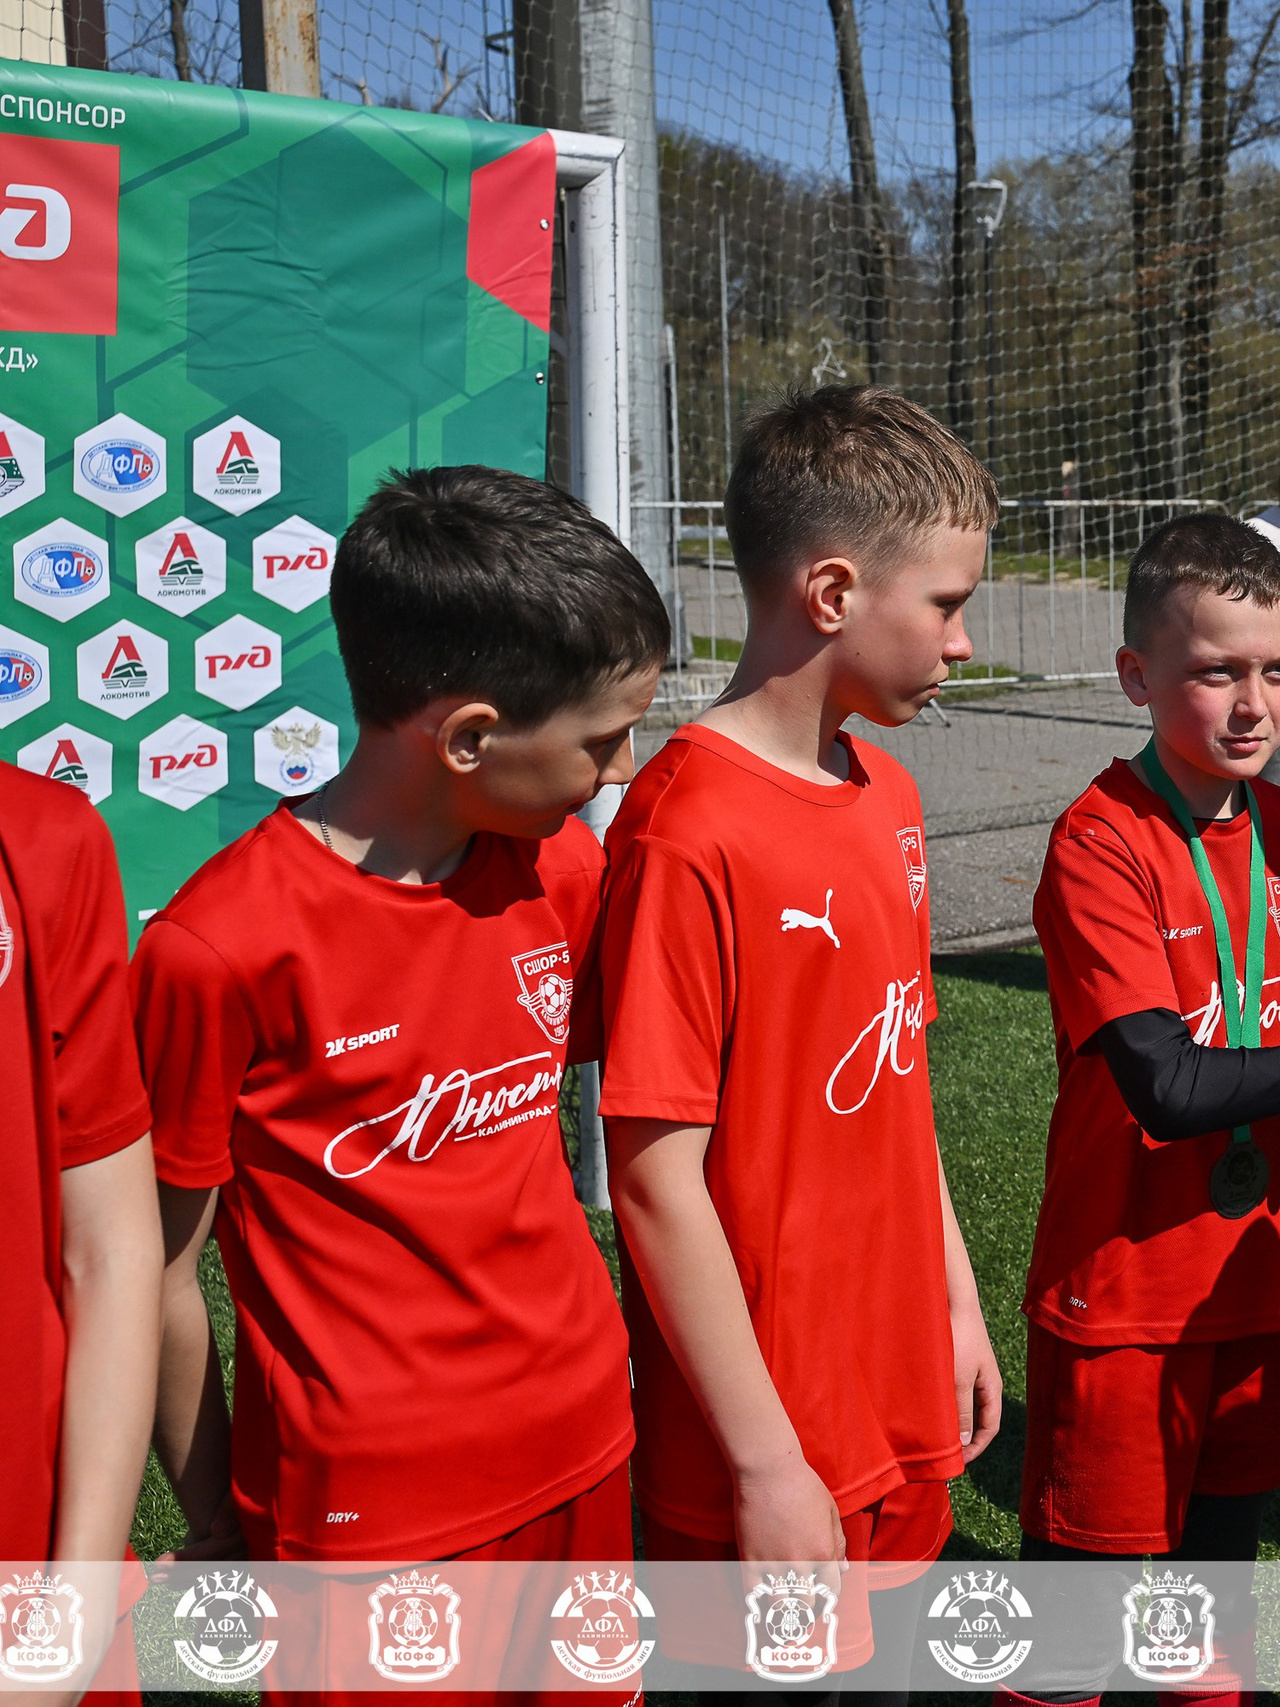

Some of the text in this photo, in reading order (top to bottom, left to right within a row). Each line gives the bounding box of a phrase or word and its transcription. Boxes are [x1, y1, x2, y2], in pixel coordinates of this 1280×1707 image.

[0, 94, 126, 129] СПОНСОР
[96, 453, 145, 478] ДФЛ
[213, 488, 262, 496] ЛОКОМОТИВ
[37, 557, 86, 583] ДФЛ
[157, 589, 207, 597] ЛОКОМОТИВ
[100, 691, 151, 700] ЛОКОМОТИВ
[347, 1024, 400, 1050] SPORT
[477, 1105, 552, 1138] КАЛИНИНГРАД
[326, 1512, 360, 1523] DRY+
